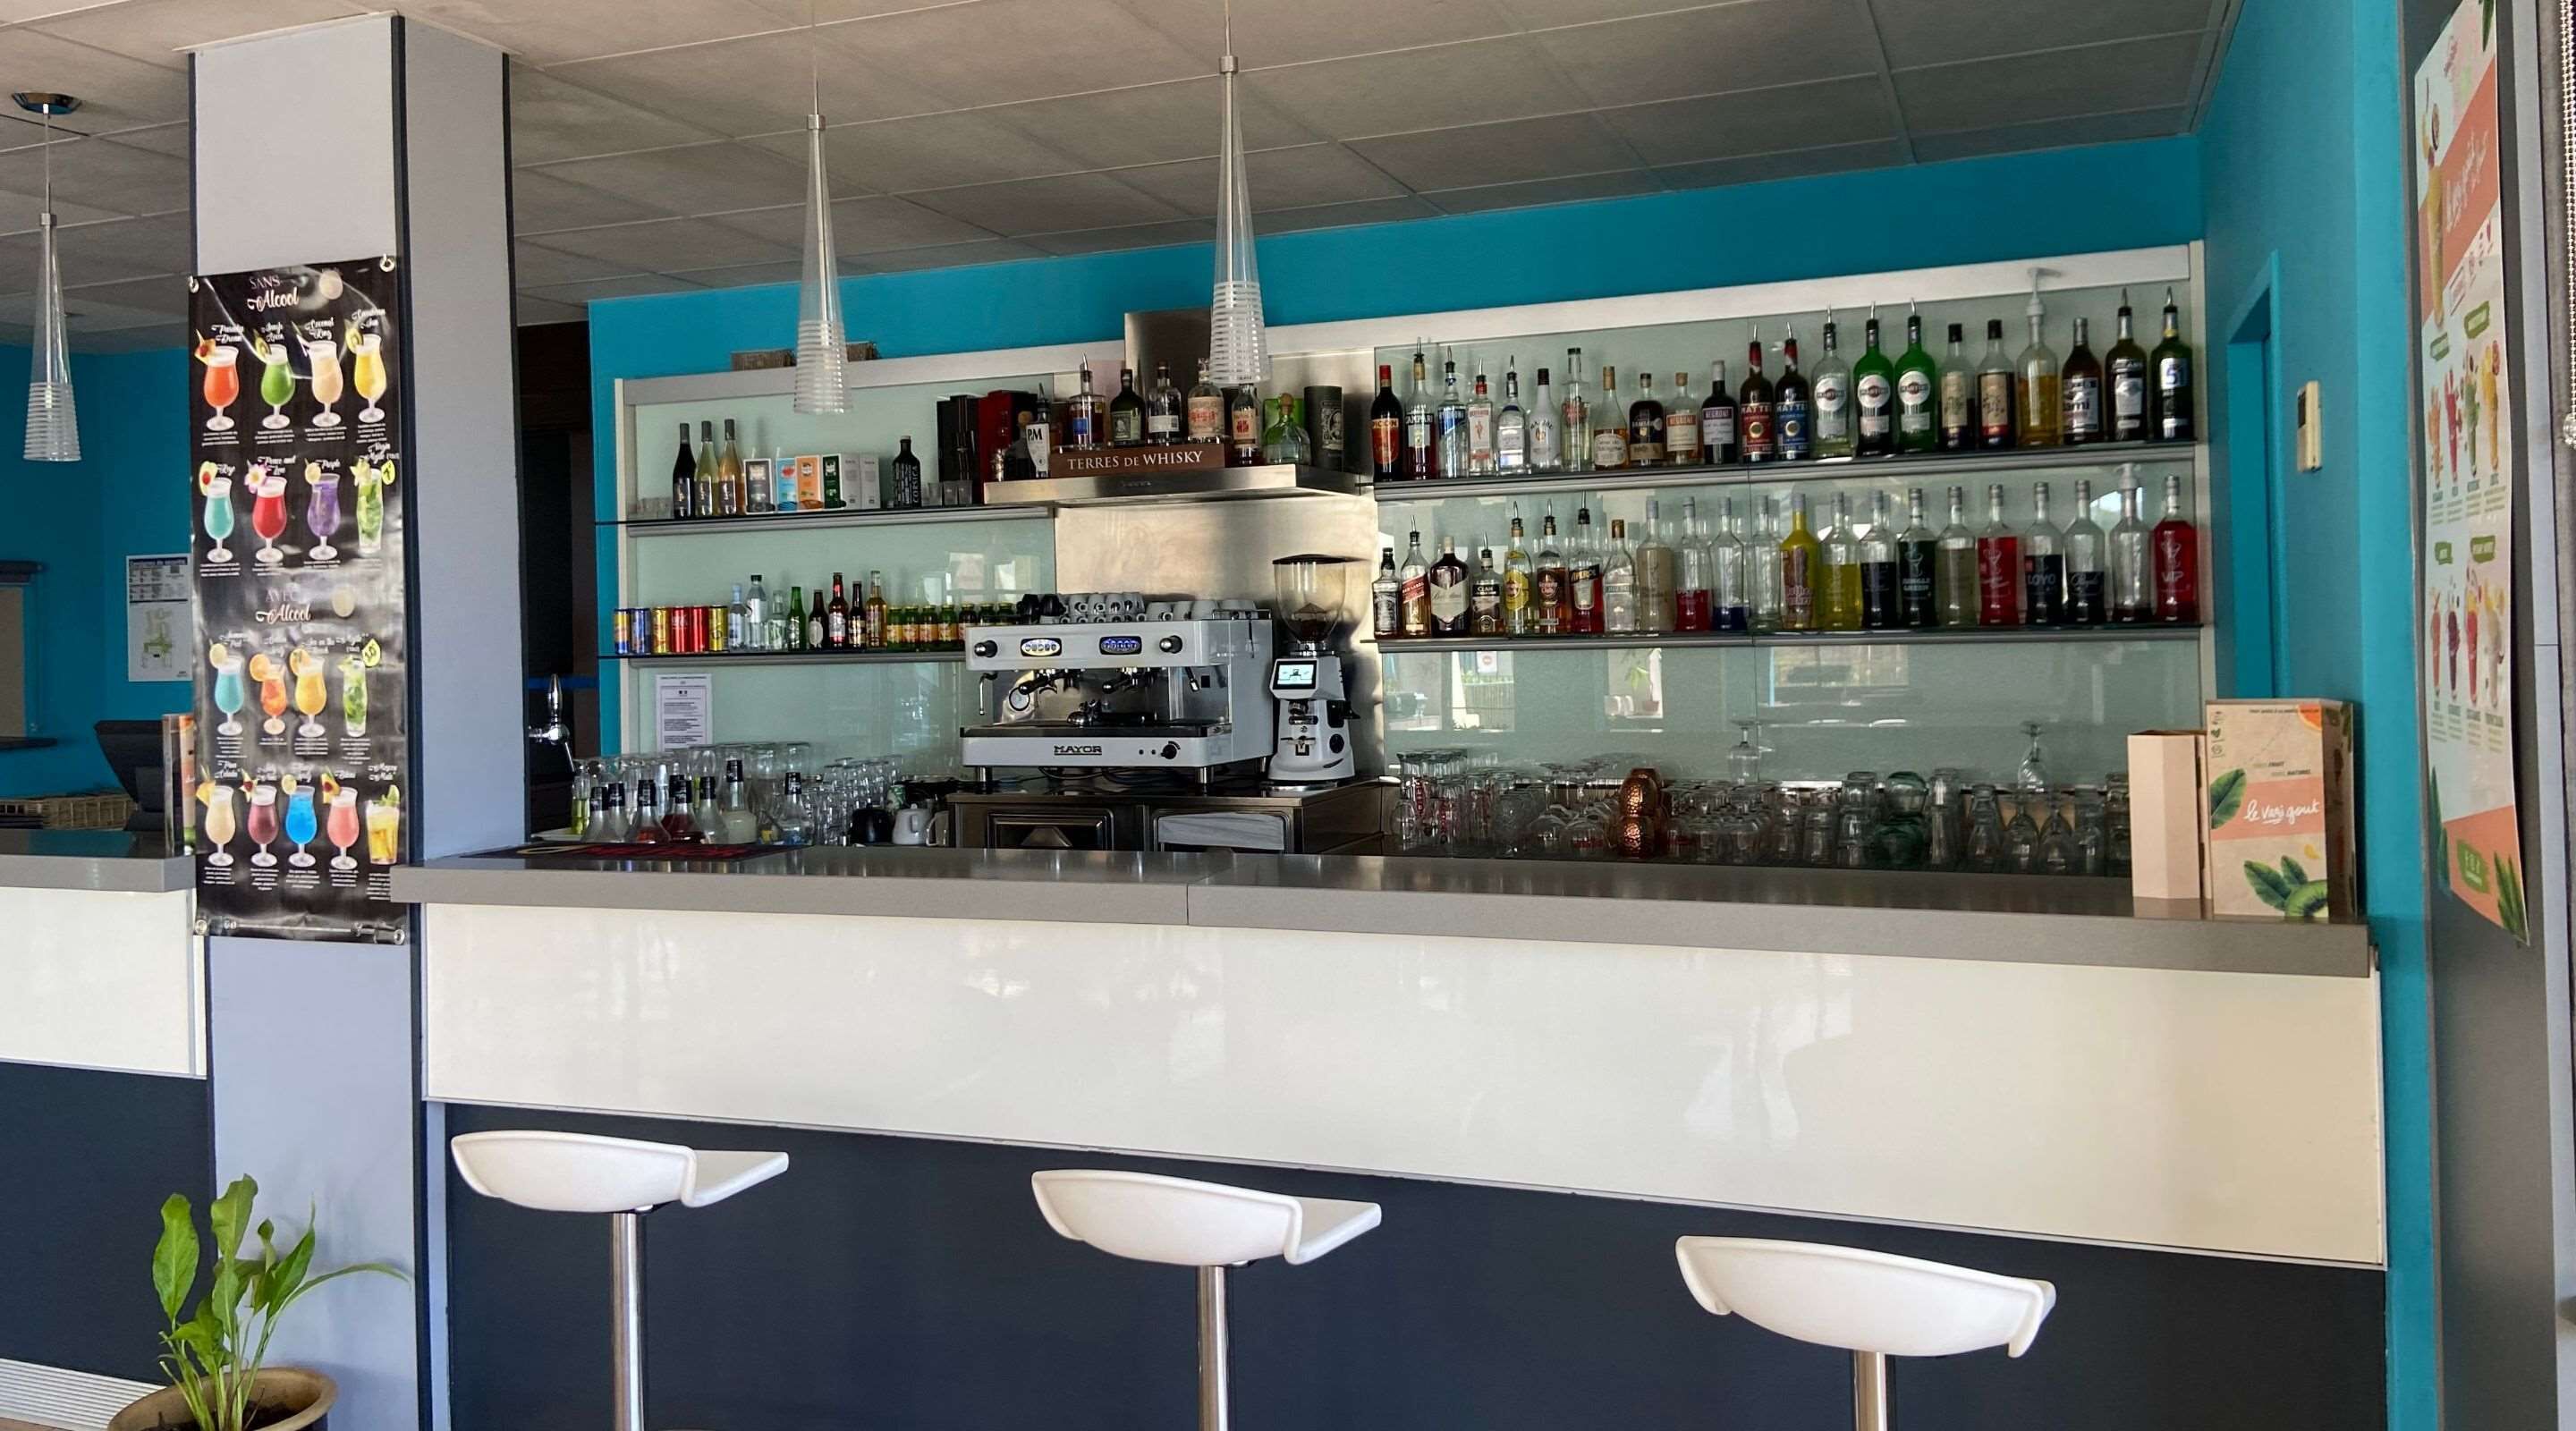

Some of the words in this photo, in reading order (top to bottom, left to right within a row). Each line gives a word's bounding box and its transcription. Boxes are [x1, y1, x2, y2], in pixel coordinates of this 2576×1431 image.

[249, 274, 281, 289] SANS
[246, 286, 300, 312] Alcool
[1067, 455, 1119, 470] TERRES
[1124, 457, 1140, 467] DE
[1143, 451, 1203, 466] WHISKY
[2162, 571, 2183, 582] VIP
[255, 602, 311, 624] Alcool
[1054, 745, 1102, 756] MAYOR
